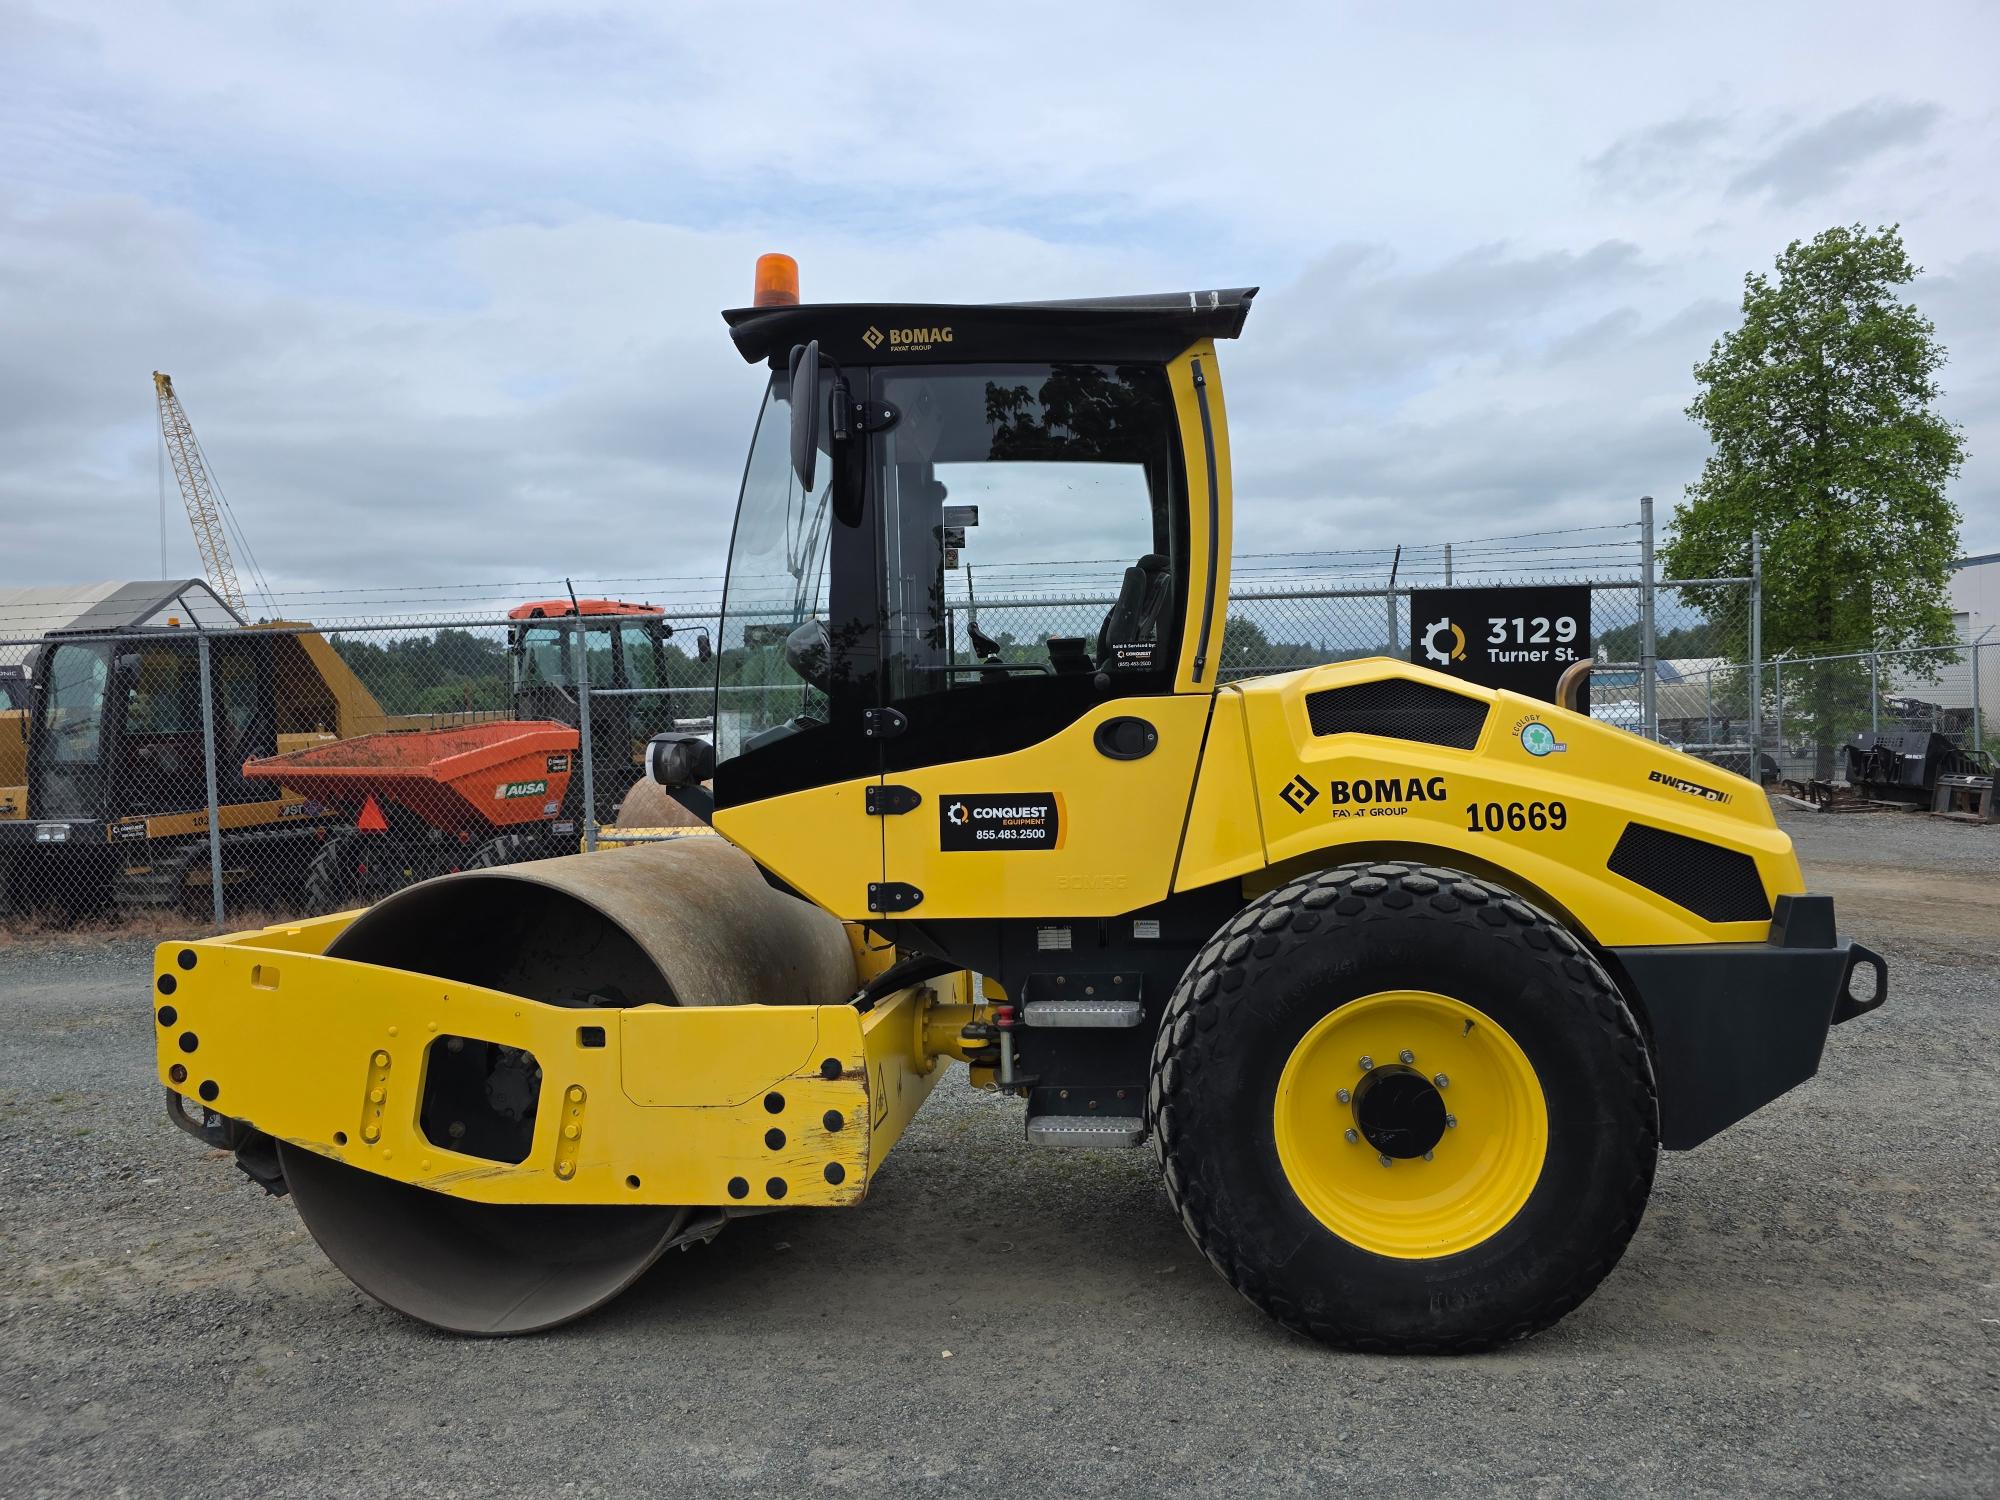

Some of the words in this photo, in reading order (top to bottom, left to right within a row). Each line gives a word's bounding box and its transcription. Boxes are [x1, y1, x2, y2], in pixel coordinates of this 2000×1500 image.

[889, 327, 953, 344] BOMAG
[1486, 616, 1578, 644] 3129
[1487, 648, 1549, 663] Turner
[1554, 647, 1580, 662] St.
[1512, 714, 1541, 737] ECOLOGY
[506, 783, 545, 796] AUSA
[1330, 777, 1447, 804] BOMAG
[972, 806, 1048, 819] CONQUEST
[1369, 807, 1408, 816] GROUP
[1466, 801, 1568, 832] 10669
[976, 829, 1046, 839] 855.483.2500
